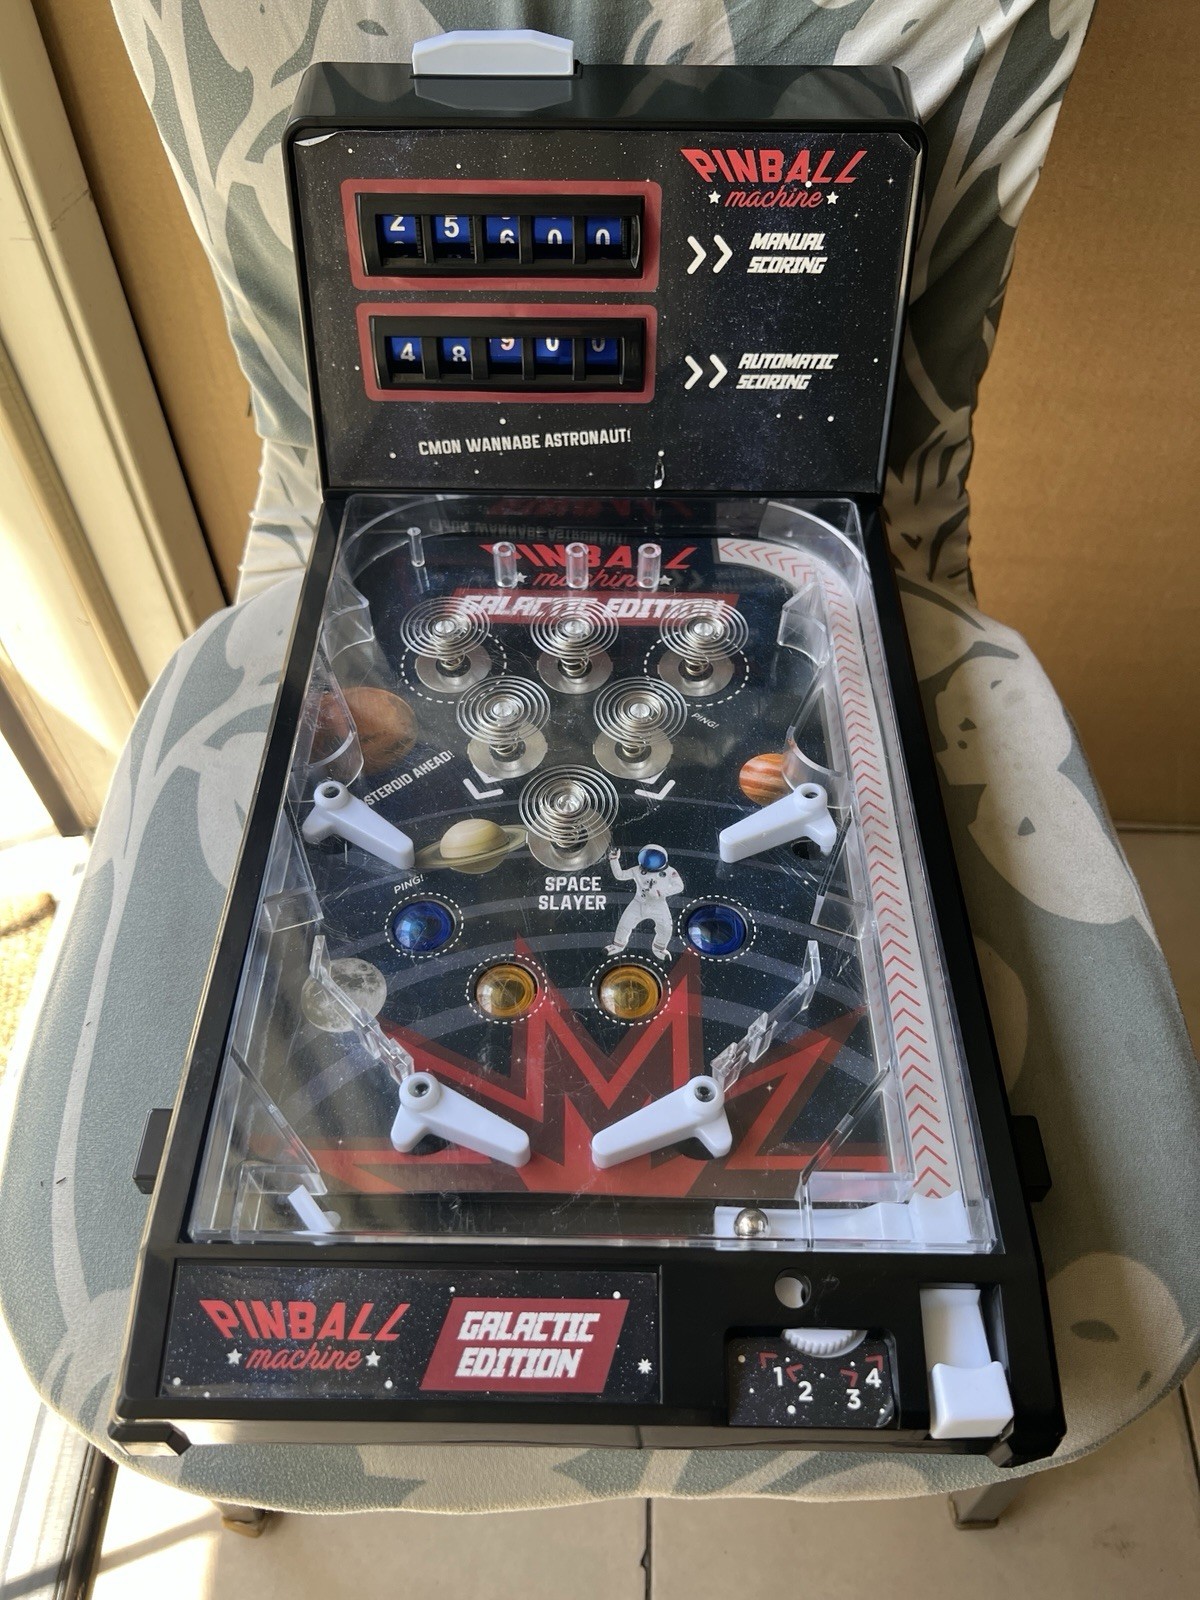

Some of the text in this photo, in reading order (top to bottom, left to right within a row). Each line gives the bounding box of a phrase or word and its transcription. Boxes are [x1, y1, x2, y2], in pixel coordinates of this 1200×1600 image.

[679, 149, 868, 184] PINBALL
[724, 184, 824, 208] machine
[748, 232, 826, 251] MANUAL
[746, 256, 828, 274] SCORING
[737, 353, 840, 370] AUTOMATIC
[735, 374, 813, 390] SCORING
[418, 428, 632, 457] CMON WANNABE ASTRONAUT!
[479, 543, 698, 569] INBAL
[532, 568, 646, 588] mahin
[691, 712, 720, 729] PING!
[362, 749, 456, 806] STEROID AHEAD!
[393, 873, 425, 895] PING!
[545, 876, 602, 892] SPACE
[538, 894, 607, 911] SLAYER
[200, 1299, 411, 1341] PINBALL
[456, 1310, 601, 1342] GALACTIC
[245, 1341, 363, 1371] machine
[454, 1346, 584, 1378] EDITION
[773, 1366, 784, 1387] 1
[865, 1367, 882, 1388] 4
[798, 1380, 814, 1402] 2
[846, 1388, 861, 1410] 3
